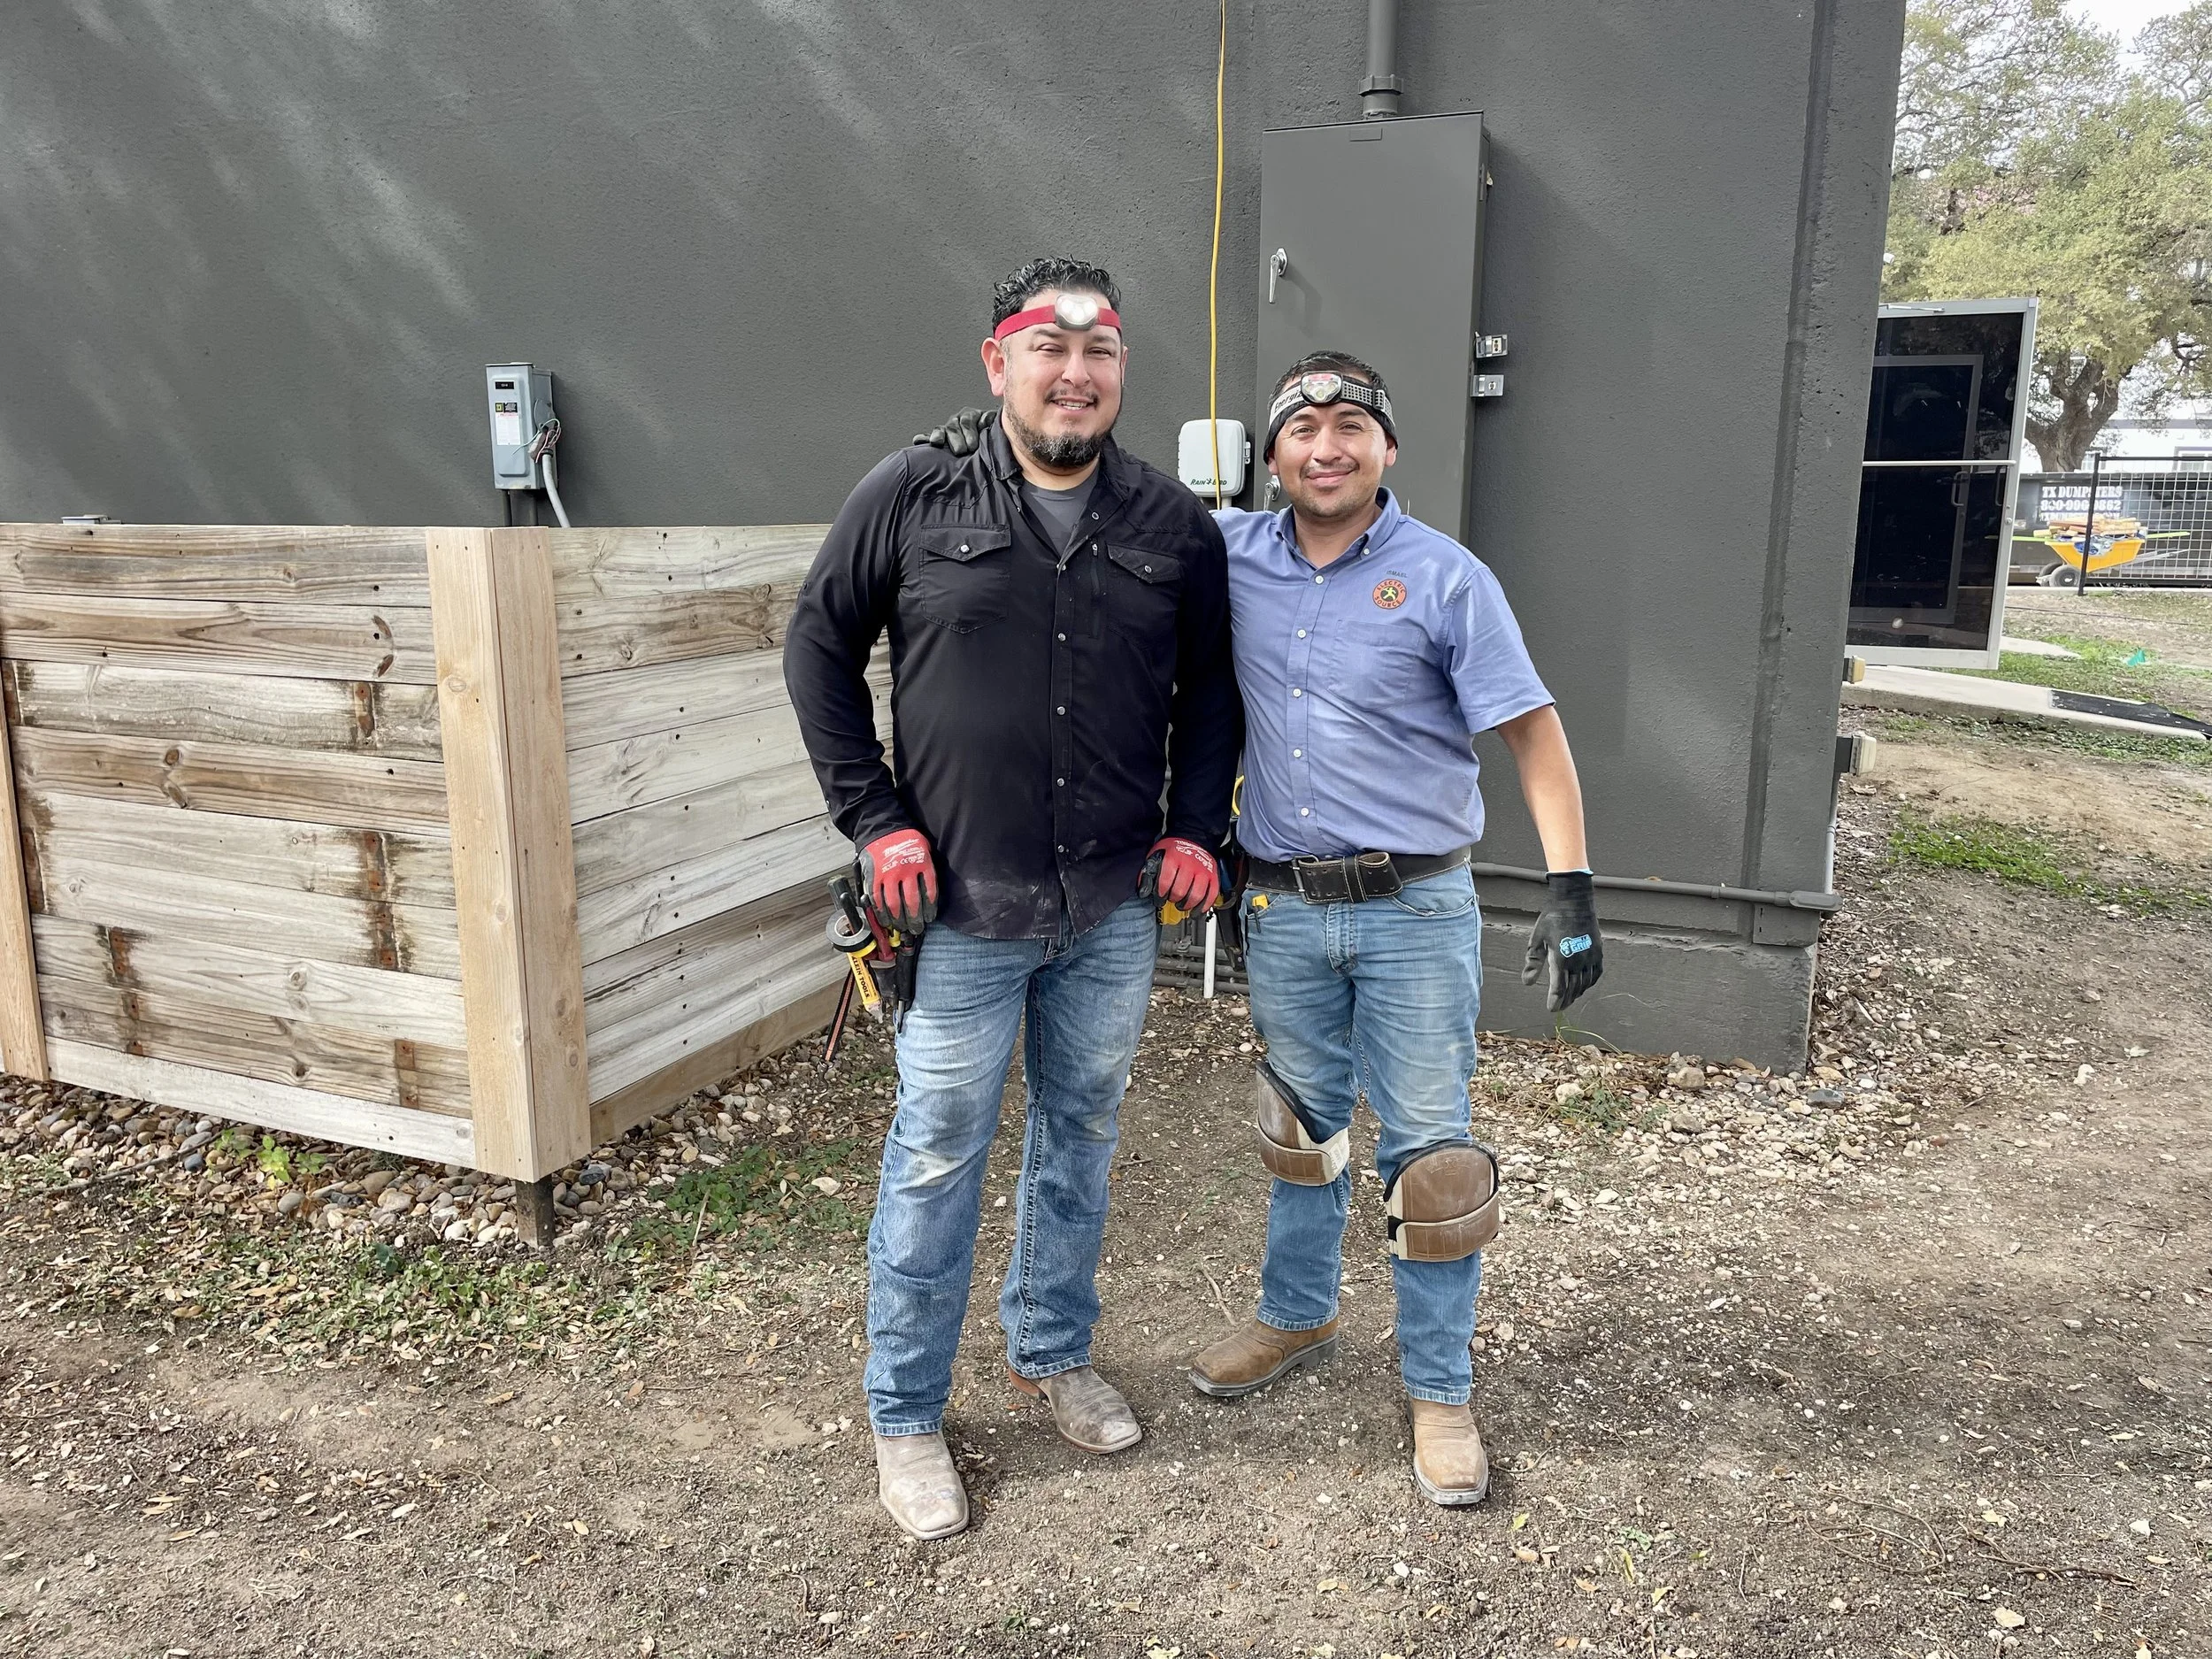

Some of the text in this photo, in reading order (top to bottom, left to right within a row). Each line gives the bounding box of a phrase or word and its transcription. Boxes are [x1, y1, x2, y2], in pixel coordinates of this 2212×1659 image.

[1274, 389, 1302, 413] Energiz
[2041, 486, 2057, 498] TX
[1377, 580, 1405, 593] ELECTRIC
[859, 977, 871, 998] TOOLS
